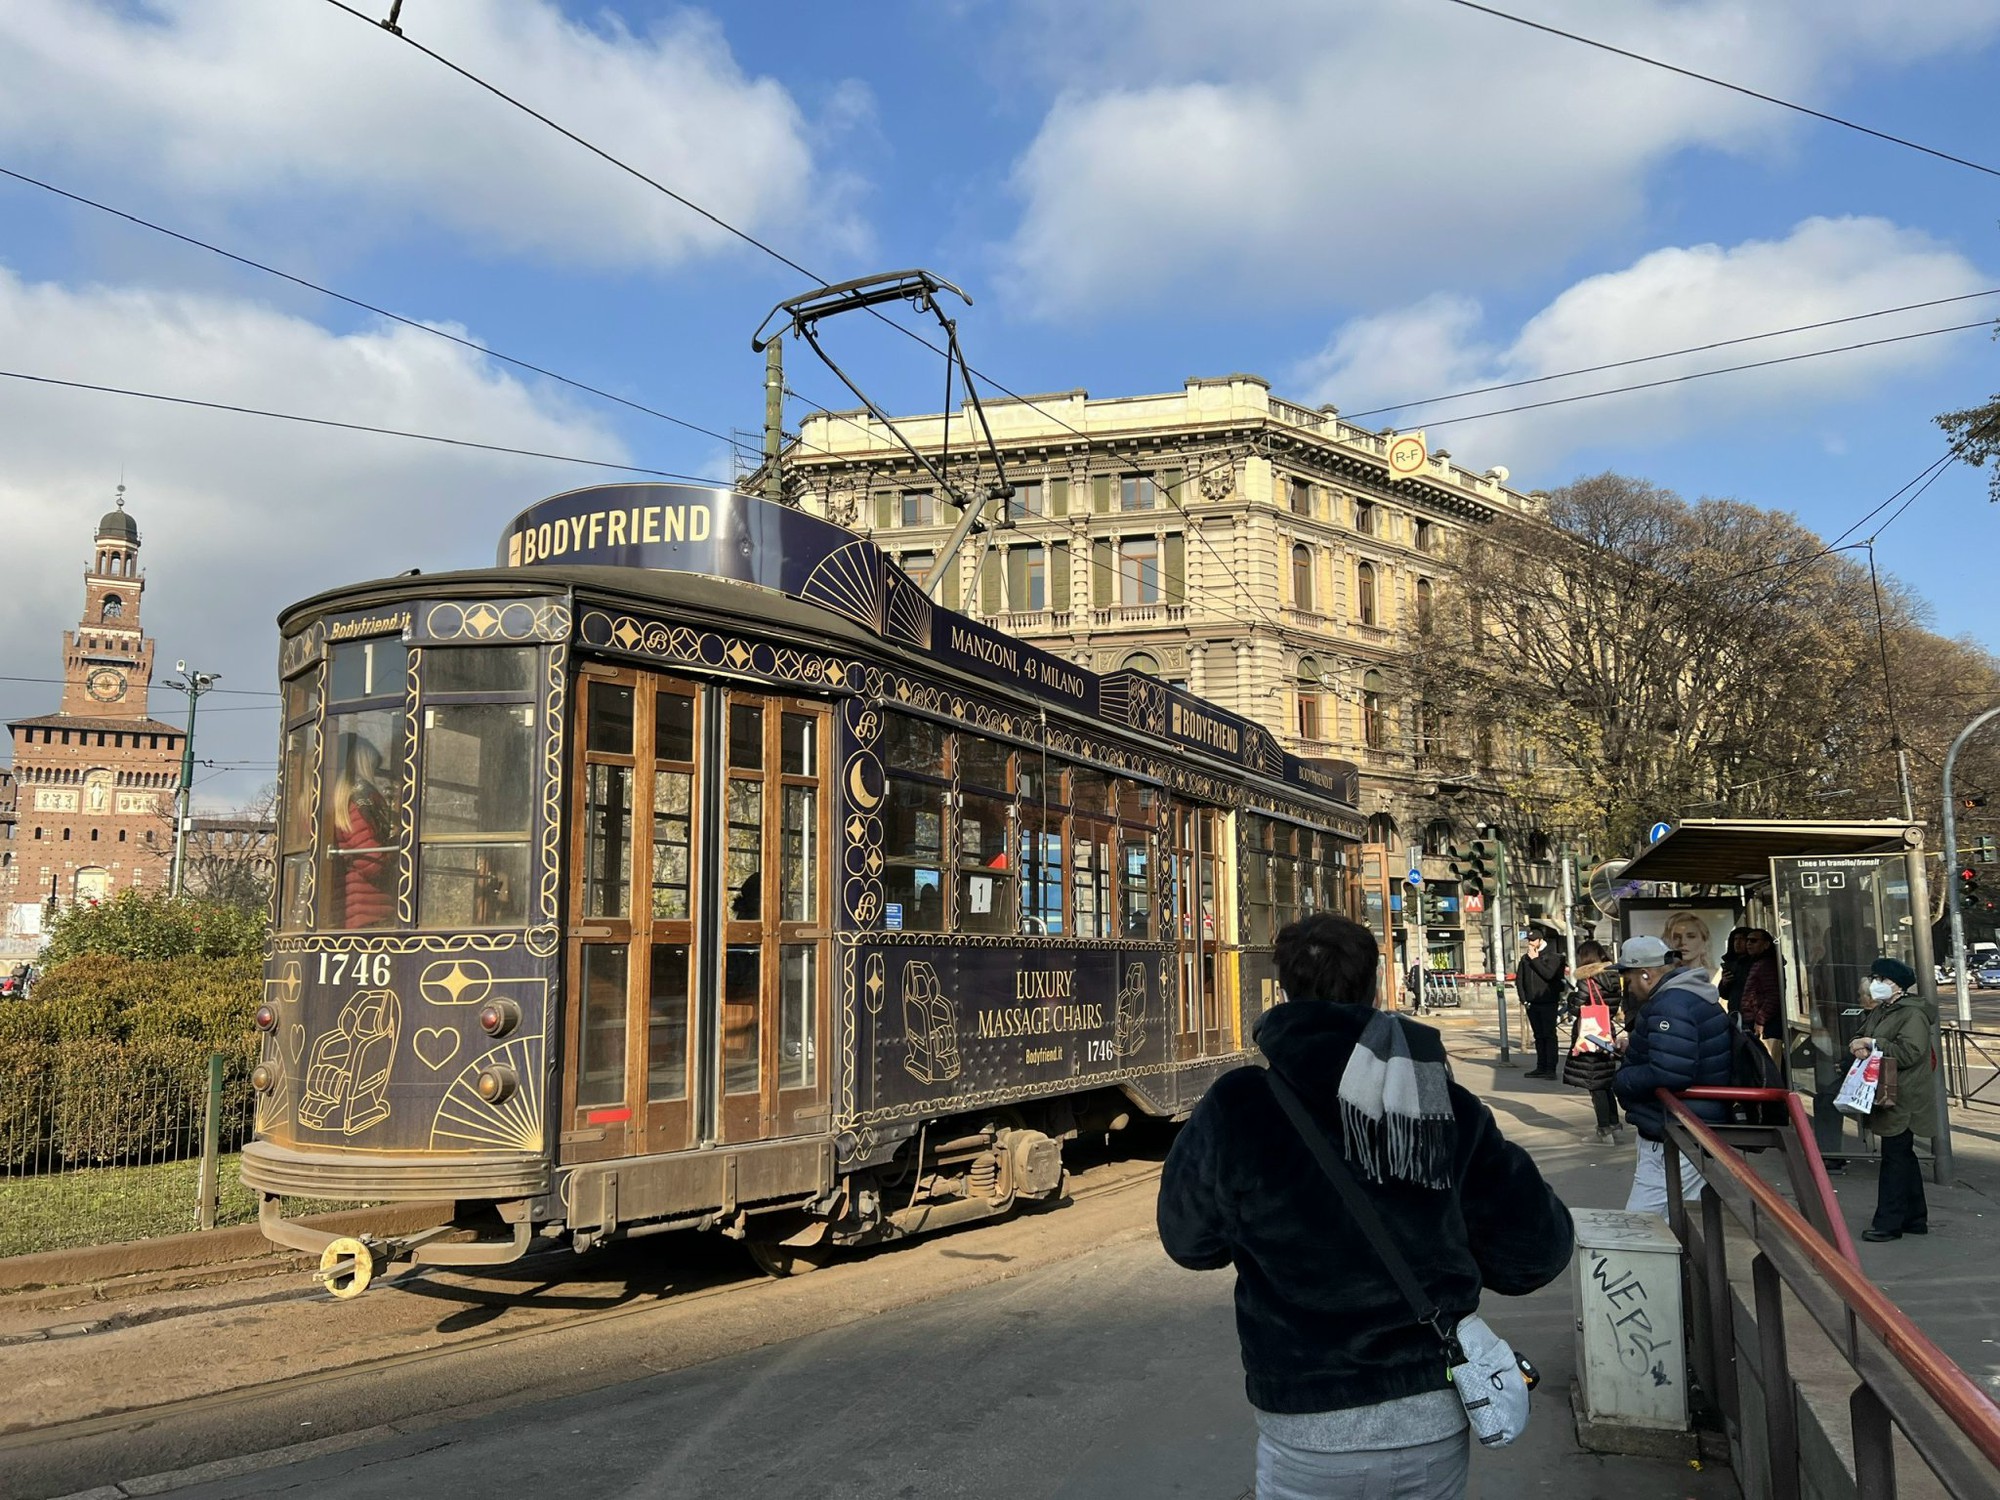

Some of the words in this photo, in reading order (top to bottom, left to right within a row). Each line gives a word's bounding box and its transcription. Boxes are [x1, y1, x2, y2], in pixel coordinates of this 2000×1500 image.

[1395, 448, 1418, 463] R-F
[524, 504, 711, 565] BODYFRIEND
[330, 611, 412, 640] Bodyfriend.it
[364, 644, 374, 694] 1
[951, 626, 1020, 678] MANZONI,
[1024, 657, 1037, 680] 43
[1040, 662, 1084, 698] MILANO
[1182, 708, 1239, 754] BODYFRIEND
[978, 883, 984, 903] 1
[1808, 875, 1813, 884] 1
[1832, 875, 1839, 884] 4
[318, 952, 392, 987] 1746
[1016, 971, 1073, 1000] LUXURY
[977, 1007, 1050, 1040] MASSAGE
[1053, 1003, 1103, 1033] CHAIRS
[1025, 1046, 1063, 1067] Bodyfriend.it
[1087, 1039, 1113, 1063] 1746
